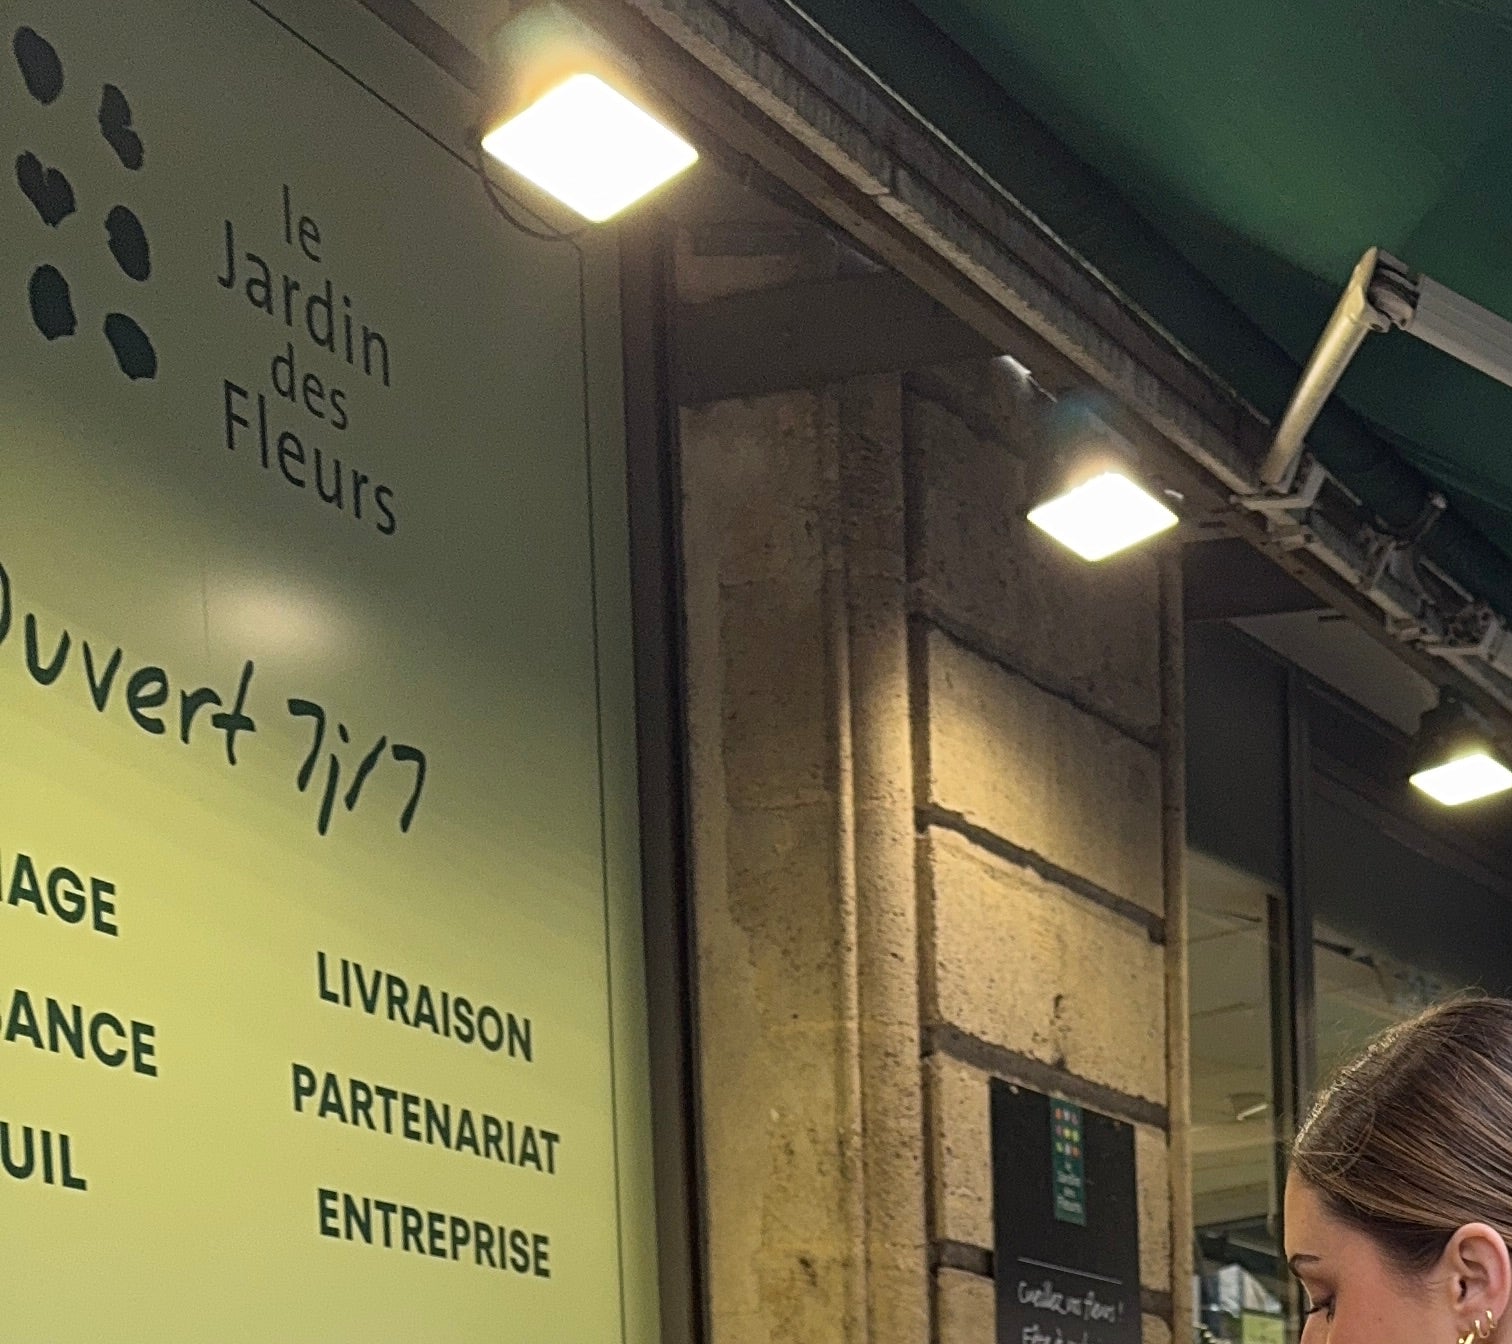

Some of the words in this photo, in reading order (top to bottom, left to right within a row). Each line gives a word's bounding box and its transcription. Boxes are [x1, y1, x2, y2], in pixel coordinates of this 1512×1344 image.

[283, 184, 321, 264] le
[217, 220, 391, 387] Jardin
[271, 345, 349, 431] des
[223, 379, 398, 536] Fleurs
[0, 562, 256, 766] uvert
[0, 851, 119, 937] AGE
[0, 987, 159, 1079] ANCE
[315, 950, 534, 1063] LIVRAISON
[292, 1062, 561, 1176] PARTENARIAT
[317, 1187, 552, 1280] ENTREPRISE
